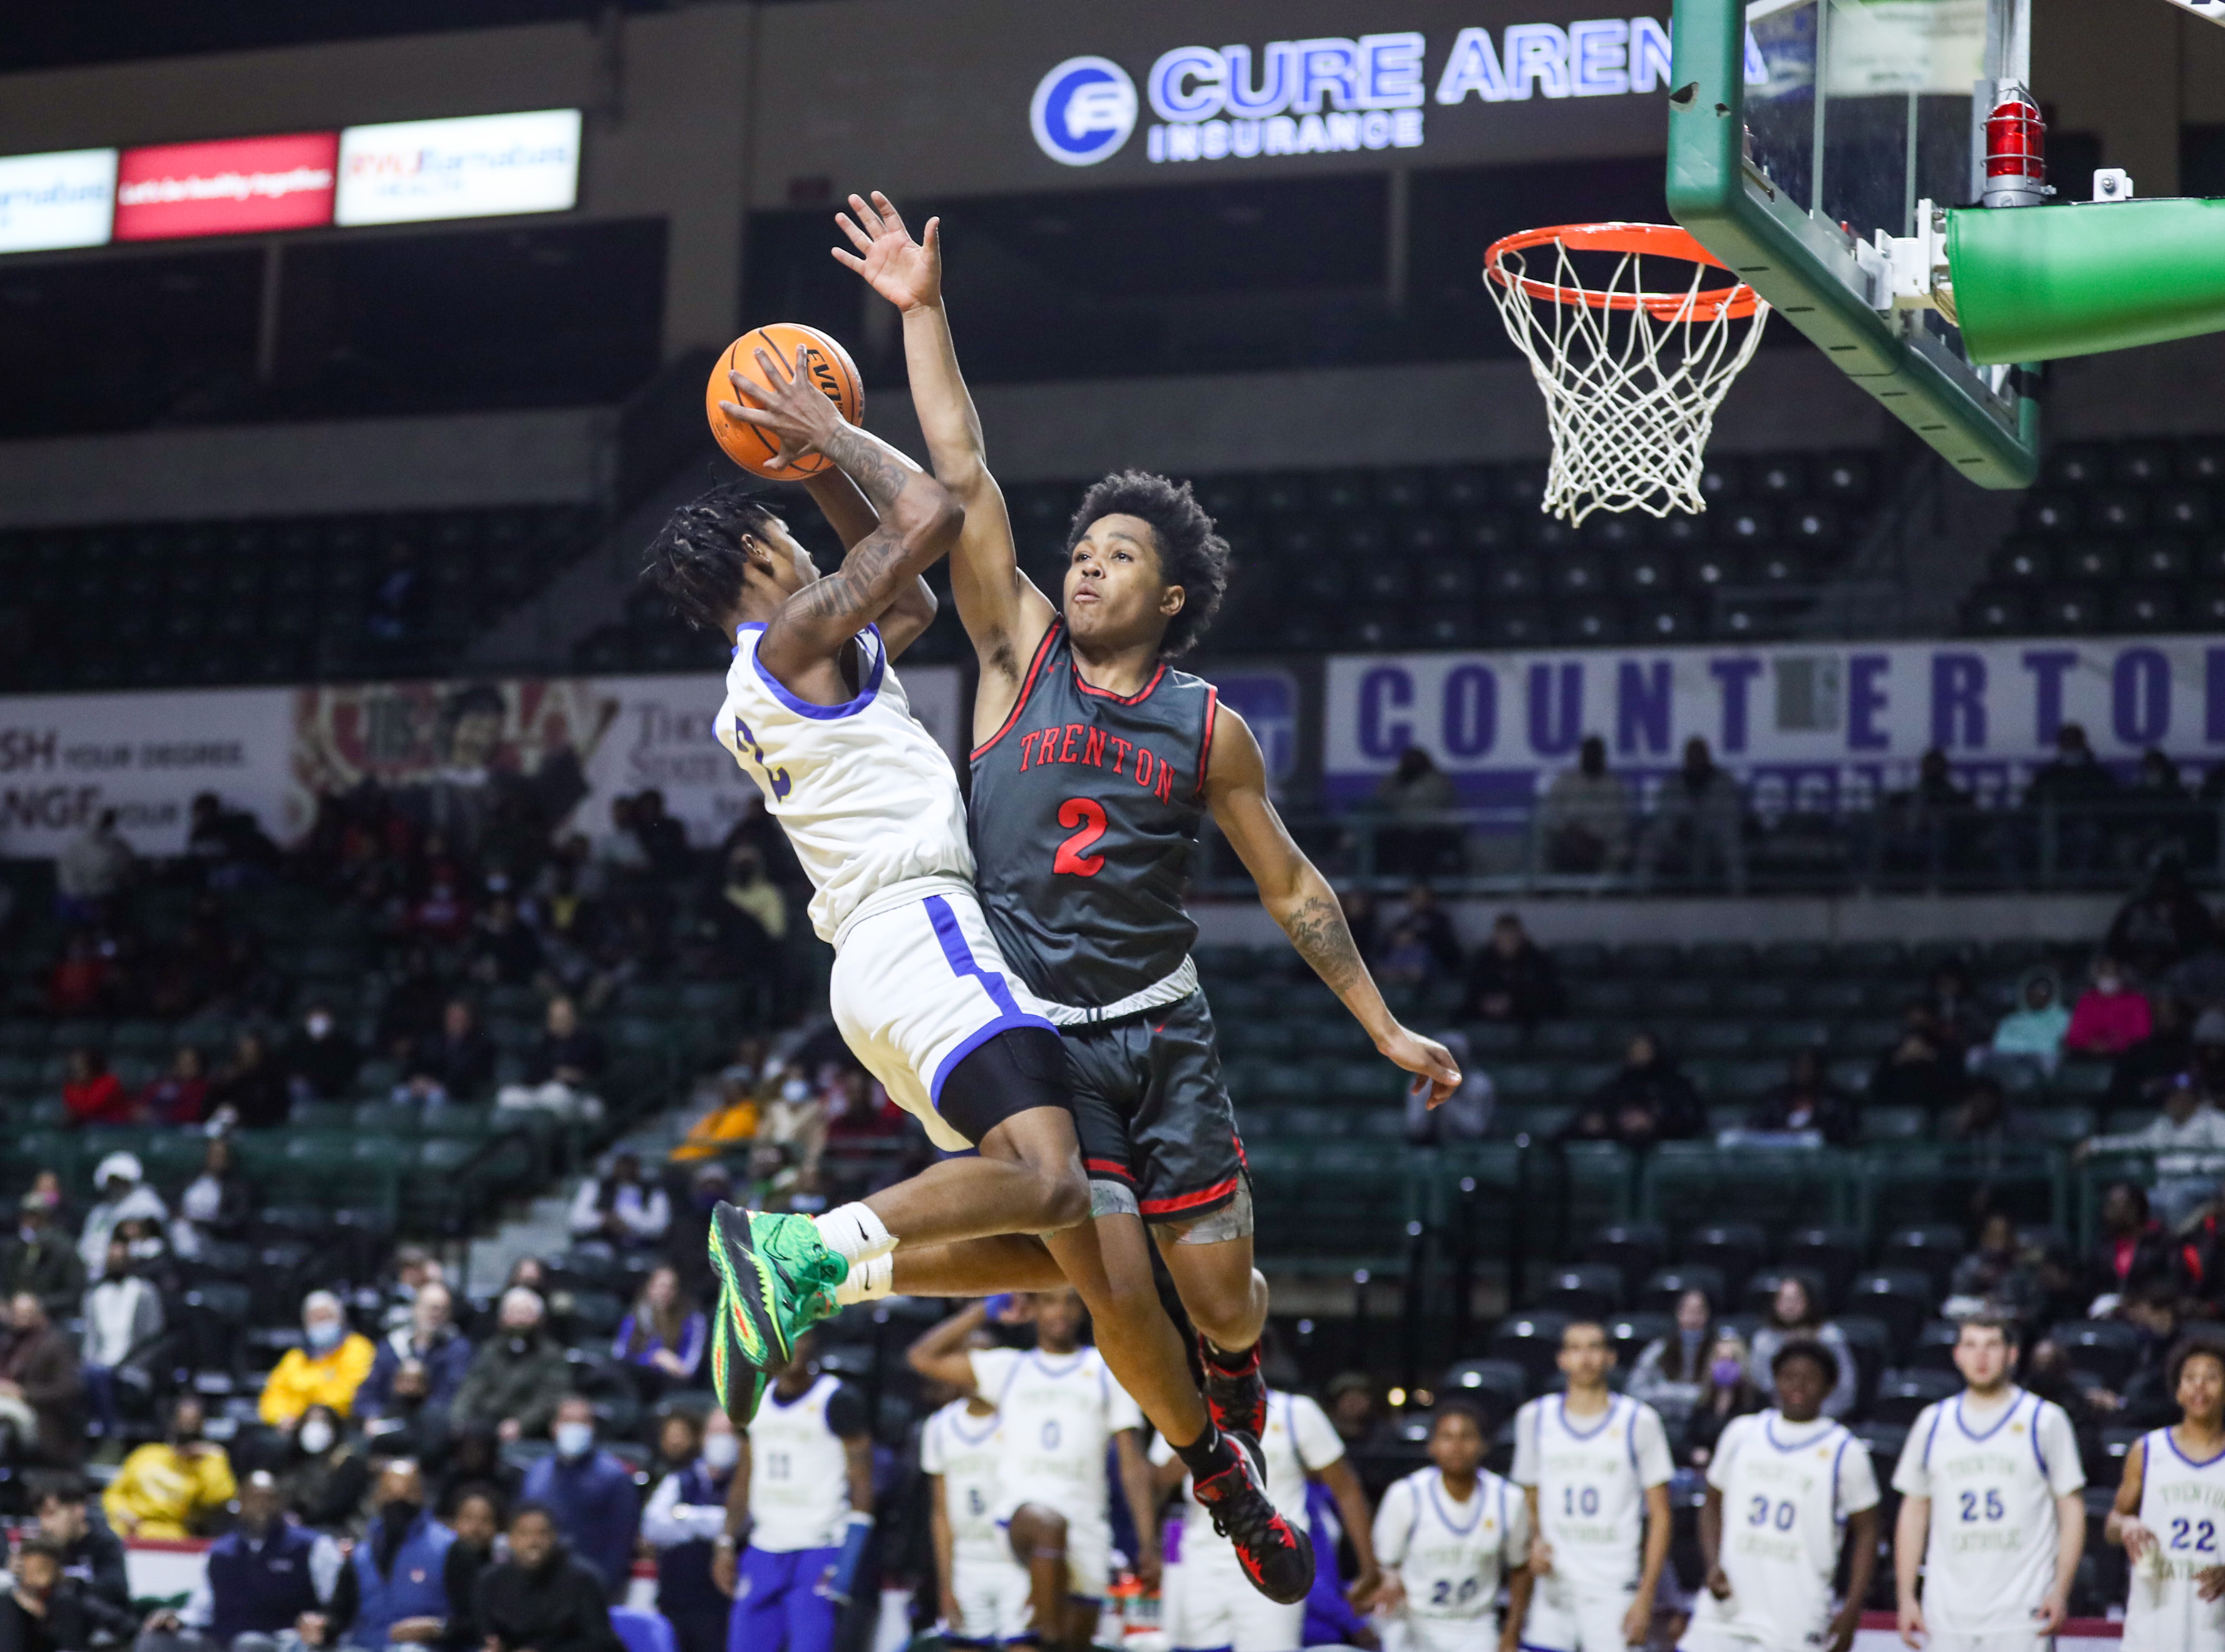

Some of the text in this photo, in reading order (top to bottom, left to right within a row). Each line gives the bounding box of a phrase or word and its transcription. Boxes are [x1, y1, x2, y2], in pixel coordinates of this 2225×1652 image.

[1148, 15, 1769, 123] CURE AREN
[1147, 107, 1425, 162] INSURANCE
[1020, 723, 1176, 806] TRENTON
[1053, 797, 1109, 877] 2
[1564, 1485, 1599, 1517] 10
[1747, 1493, 1795, 1532] 30
[1960, 1488, 2005, 1522] 25
[2170, 1516, 2216, 1552] 22
